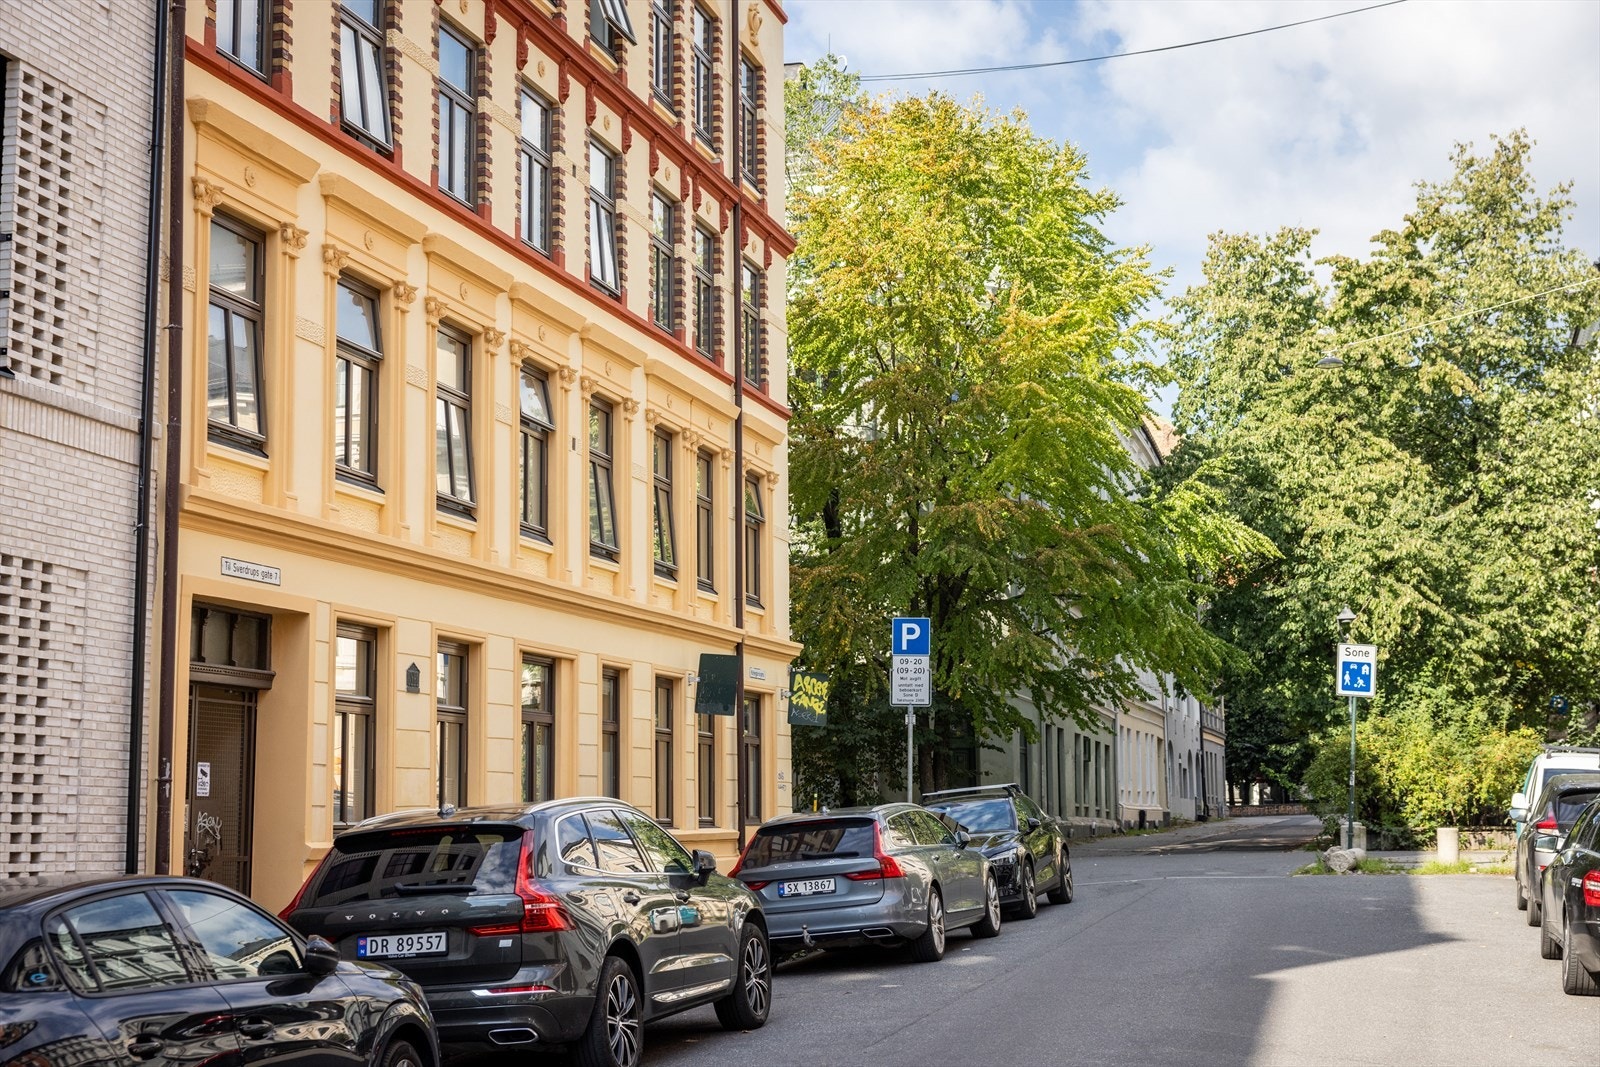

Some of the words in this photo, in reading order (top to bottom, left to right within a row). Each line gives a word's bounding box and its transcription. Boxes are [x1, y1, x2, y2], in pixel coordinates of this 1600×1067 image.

[233, 562, 259, 578] Sverdrups
[261, 570, 273, 580] gate
[902, 623, 921, 650] P
[1345, 647, 1370, 657] Sone
[787, 882, 799, 893] SX
[804, 880, 832, 891] 13867
[345, 908, 449, 921] VOLVO
[369, 938, 389, 954] DR
[396, 935, 443, 952] 89557
